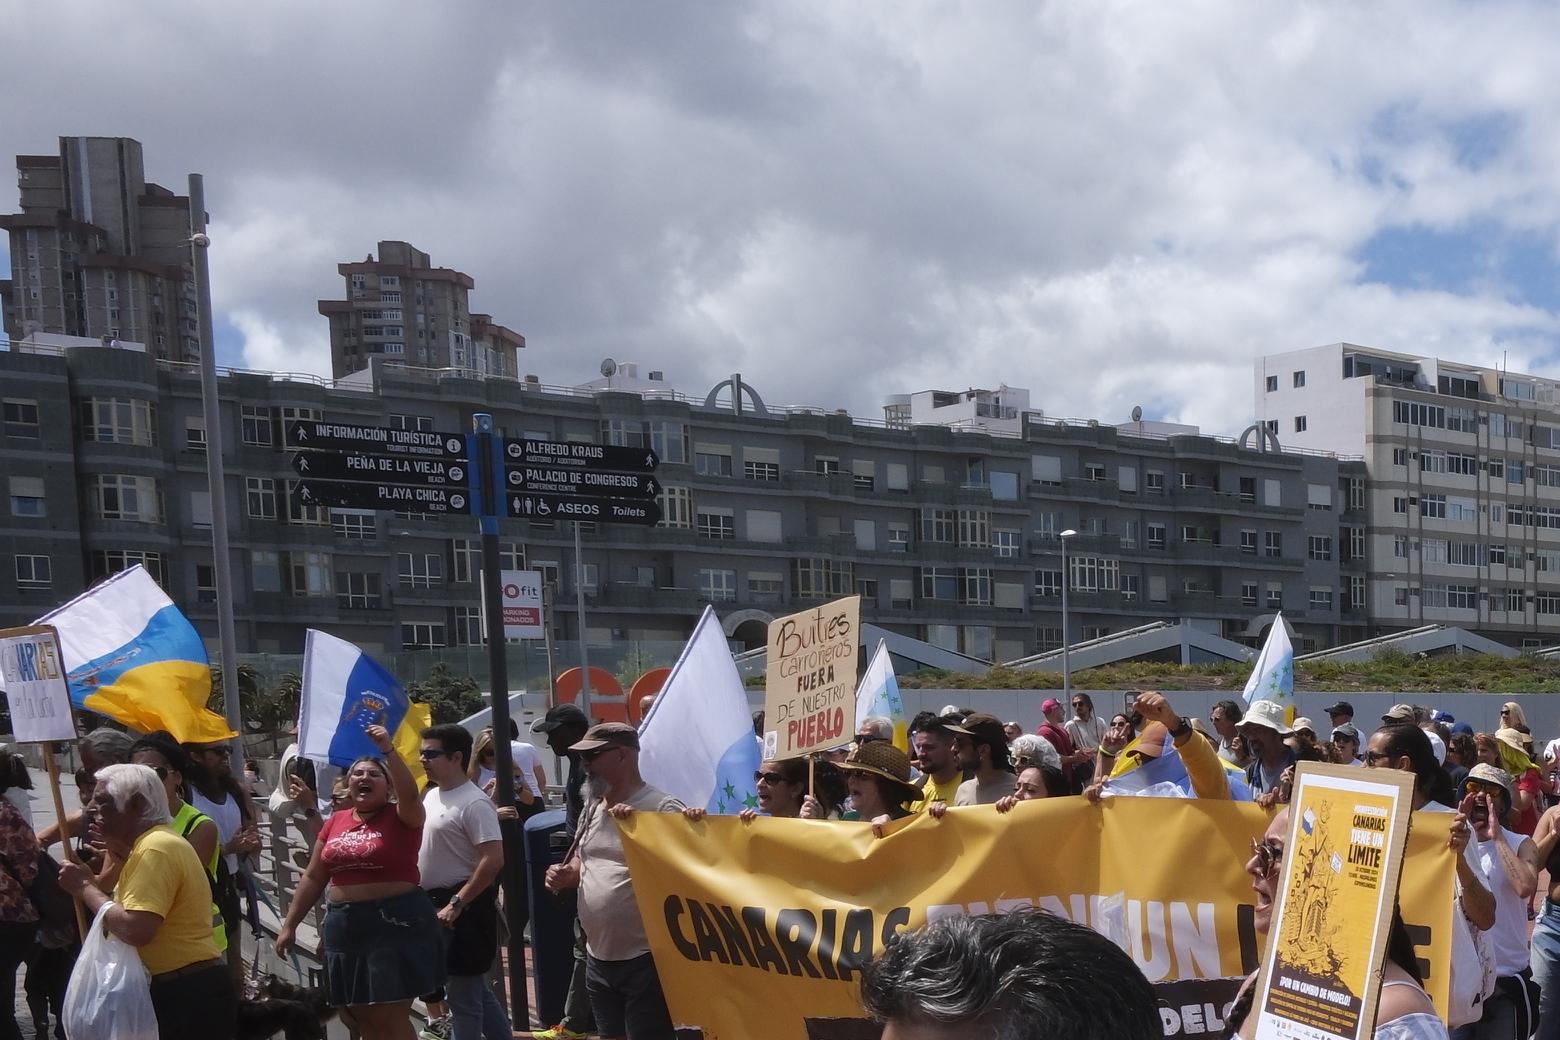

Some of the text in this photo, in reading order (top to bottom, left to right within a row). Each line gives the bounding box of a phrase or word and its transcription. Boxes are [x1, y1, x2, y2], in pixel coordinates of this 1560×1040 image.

[316, 424, 443, 446] INFORMACIÓN TURÍSTICA
[525, 442, 604, 458] ALFREDO KRAUS
[347, 455, 445, 474] PEÑA DE LA VIEJA
[427, 476, 445, 484] BEACH
[526, 469, 638, 488] PALACIO DE CONGRESOS
[378, 487, 446, 502] PLAYA CHICA
[557, 503, 646, 517] ASEOS Toilets
[521, 585, 538, 596] fit
[797, 664, 835, 693] FUERA
[777, 683, 845, 724] DE NUESTRO
[787, 706, 844, 751] PUEBLO
[1353, 814, 1386, 832] CANARIAS
[1350, 829, 1384, 848] TIENE UN
[1347, 840, 1382, 868] LÍMITE
[1127, 900, 1222, 981] UN
[1300, 981, 1320, 997] CAMBIO
[1319, 987, 1327, 999] DE
[1326, 990, 1352, 1007] MODELO!
